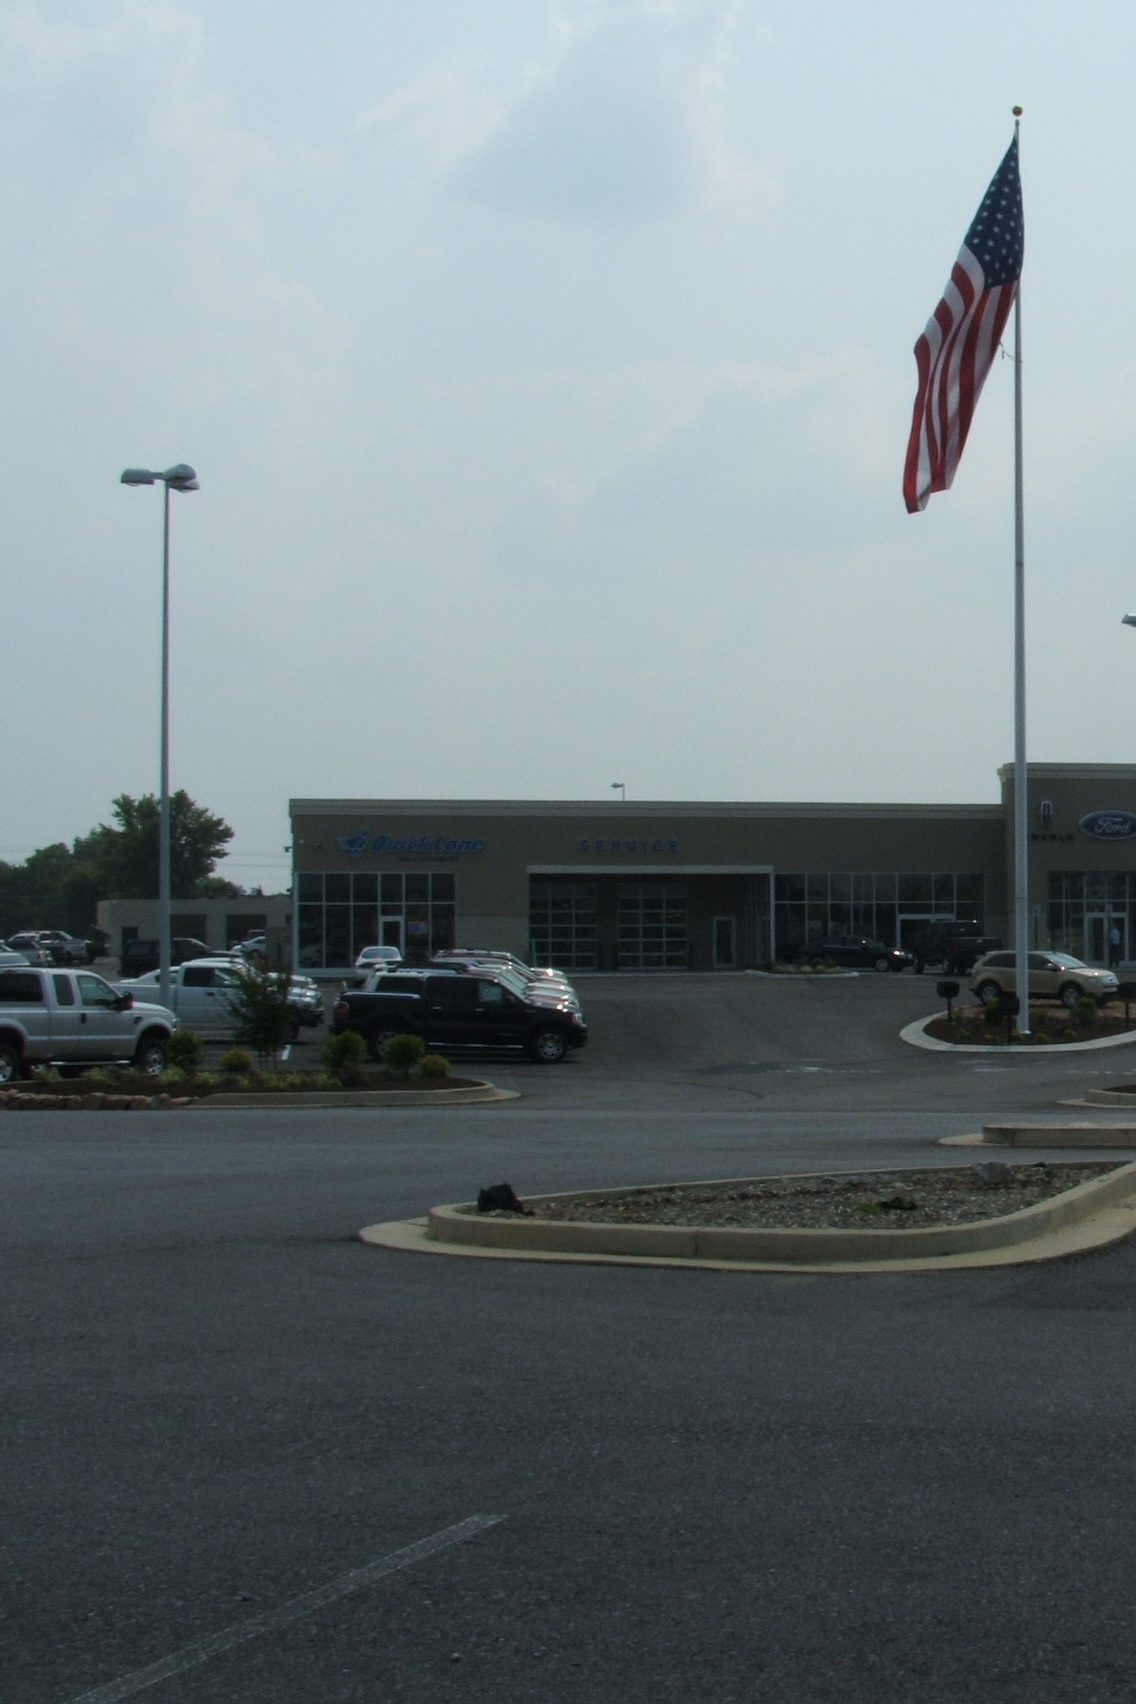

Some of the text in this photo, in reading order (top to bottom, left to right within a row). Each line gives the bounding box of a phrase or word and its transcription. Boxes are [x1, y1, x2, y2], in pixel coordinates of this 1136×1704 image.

[1094, 816, 1132, 834] Ford
[371, 834, 486, 852] Quick Lane
[579, 839, 681, 853] SERVICE
